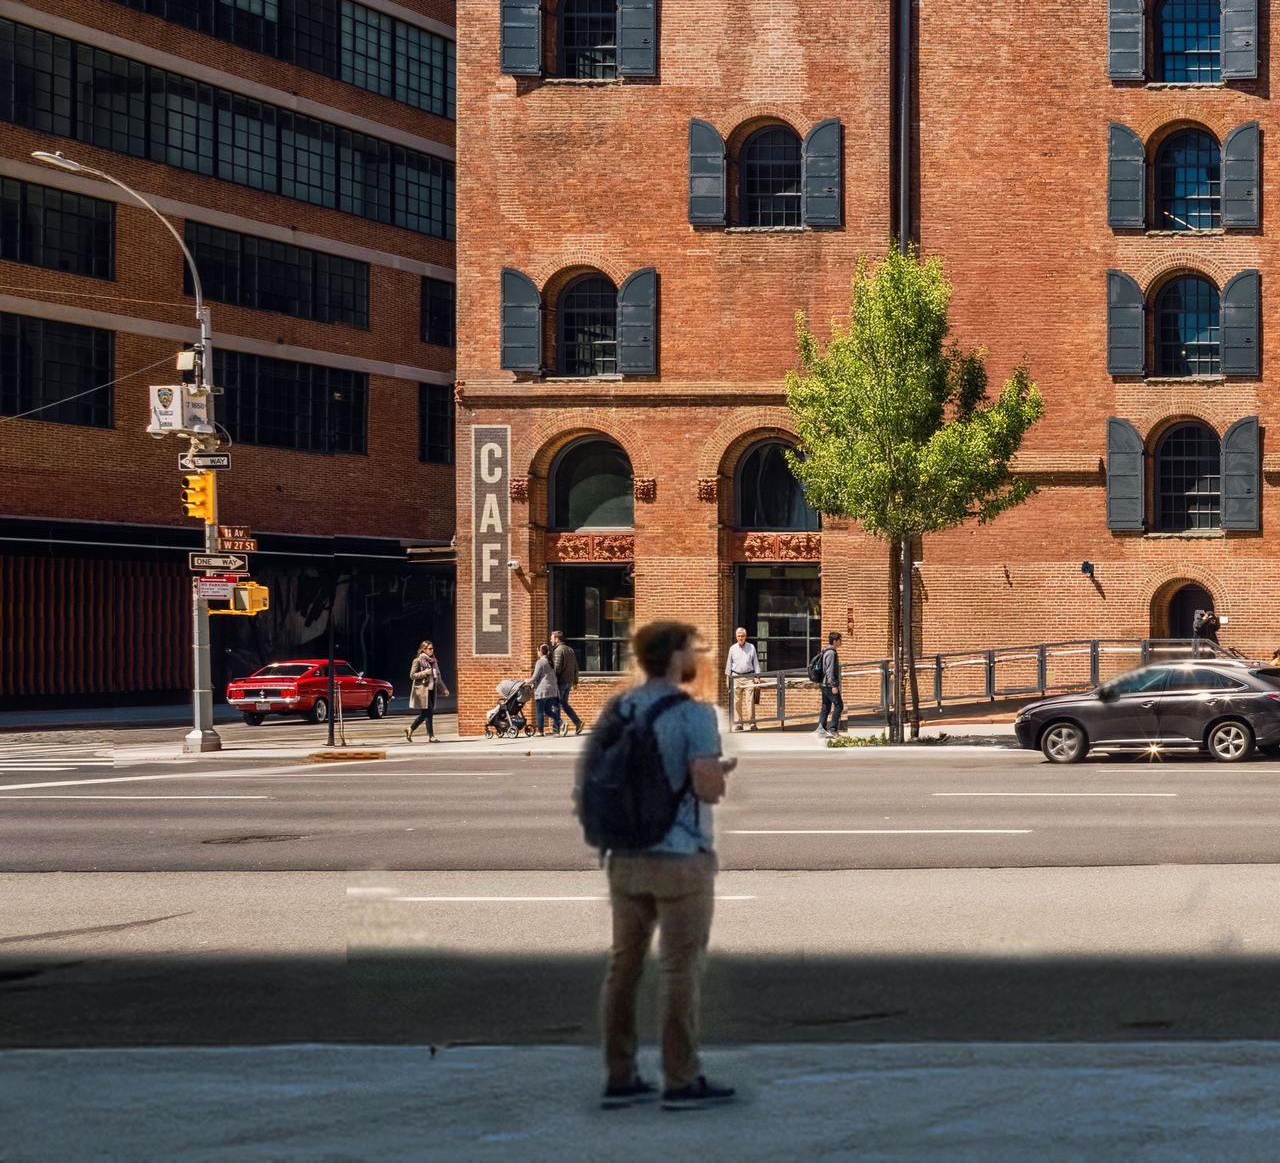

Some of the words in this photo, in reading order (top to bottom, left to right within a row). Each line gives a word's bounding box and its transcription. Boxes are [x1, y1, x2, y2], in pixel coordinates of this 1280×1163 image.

[209, 457, 226, 465] WAY
[224, 529, 232, 537] 11
[234, 529, 244, 537] Av
[479, 441, 504, 633] CAFE
[224, 541, 232, 549] W
[245, 542, 254, 550] St
